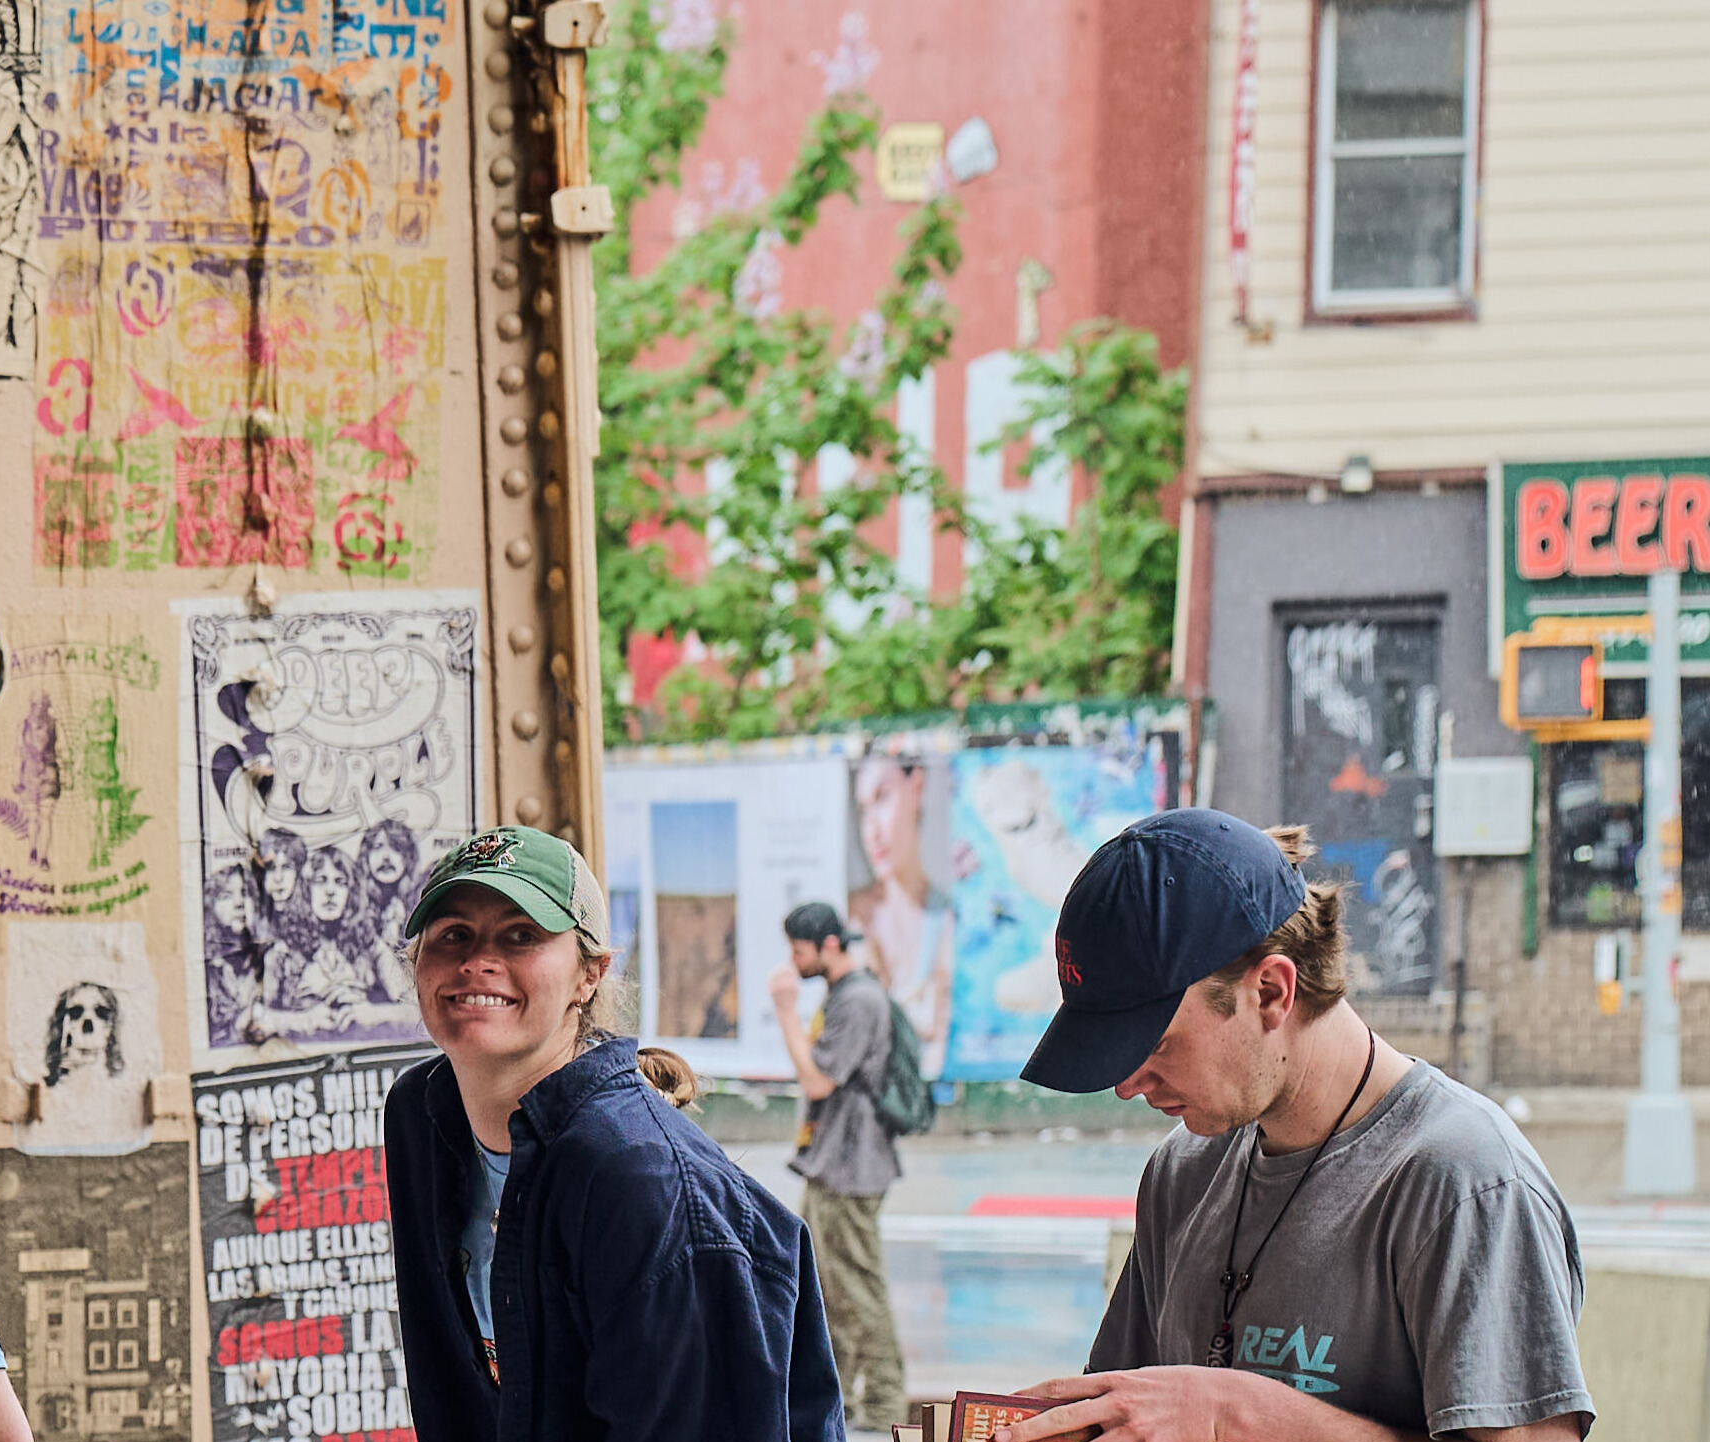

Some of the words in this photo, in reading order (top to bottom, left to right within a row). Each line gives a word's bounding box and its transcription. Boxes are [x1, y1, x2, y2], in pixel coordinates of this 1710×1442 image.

[1515, 474, 1710, 581] BEER
[241, 718, 456, 828] PURPLE
[195, 1076, 318, 1127] SOMOS
[200, 1126, 243, 1167] DE
[225, 1160, 276, 1202] DE
[213, 1228, 313, 1272] AUNQUE
[316, 1220, 391, 1259] ELLXS
[207, 1269, 255, 1302] LAS
[258, 1259, 343, 1296] ARMAS
[282, 1291, 300, 1320] Y
[217, 1315, 344, 1367] SOMOS
[351, 1310, 406, 1353] LA
[1237, 1324, 1338, 1374] REAL
[224, 1351, 385, 1406] MAYORIA
